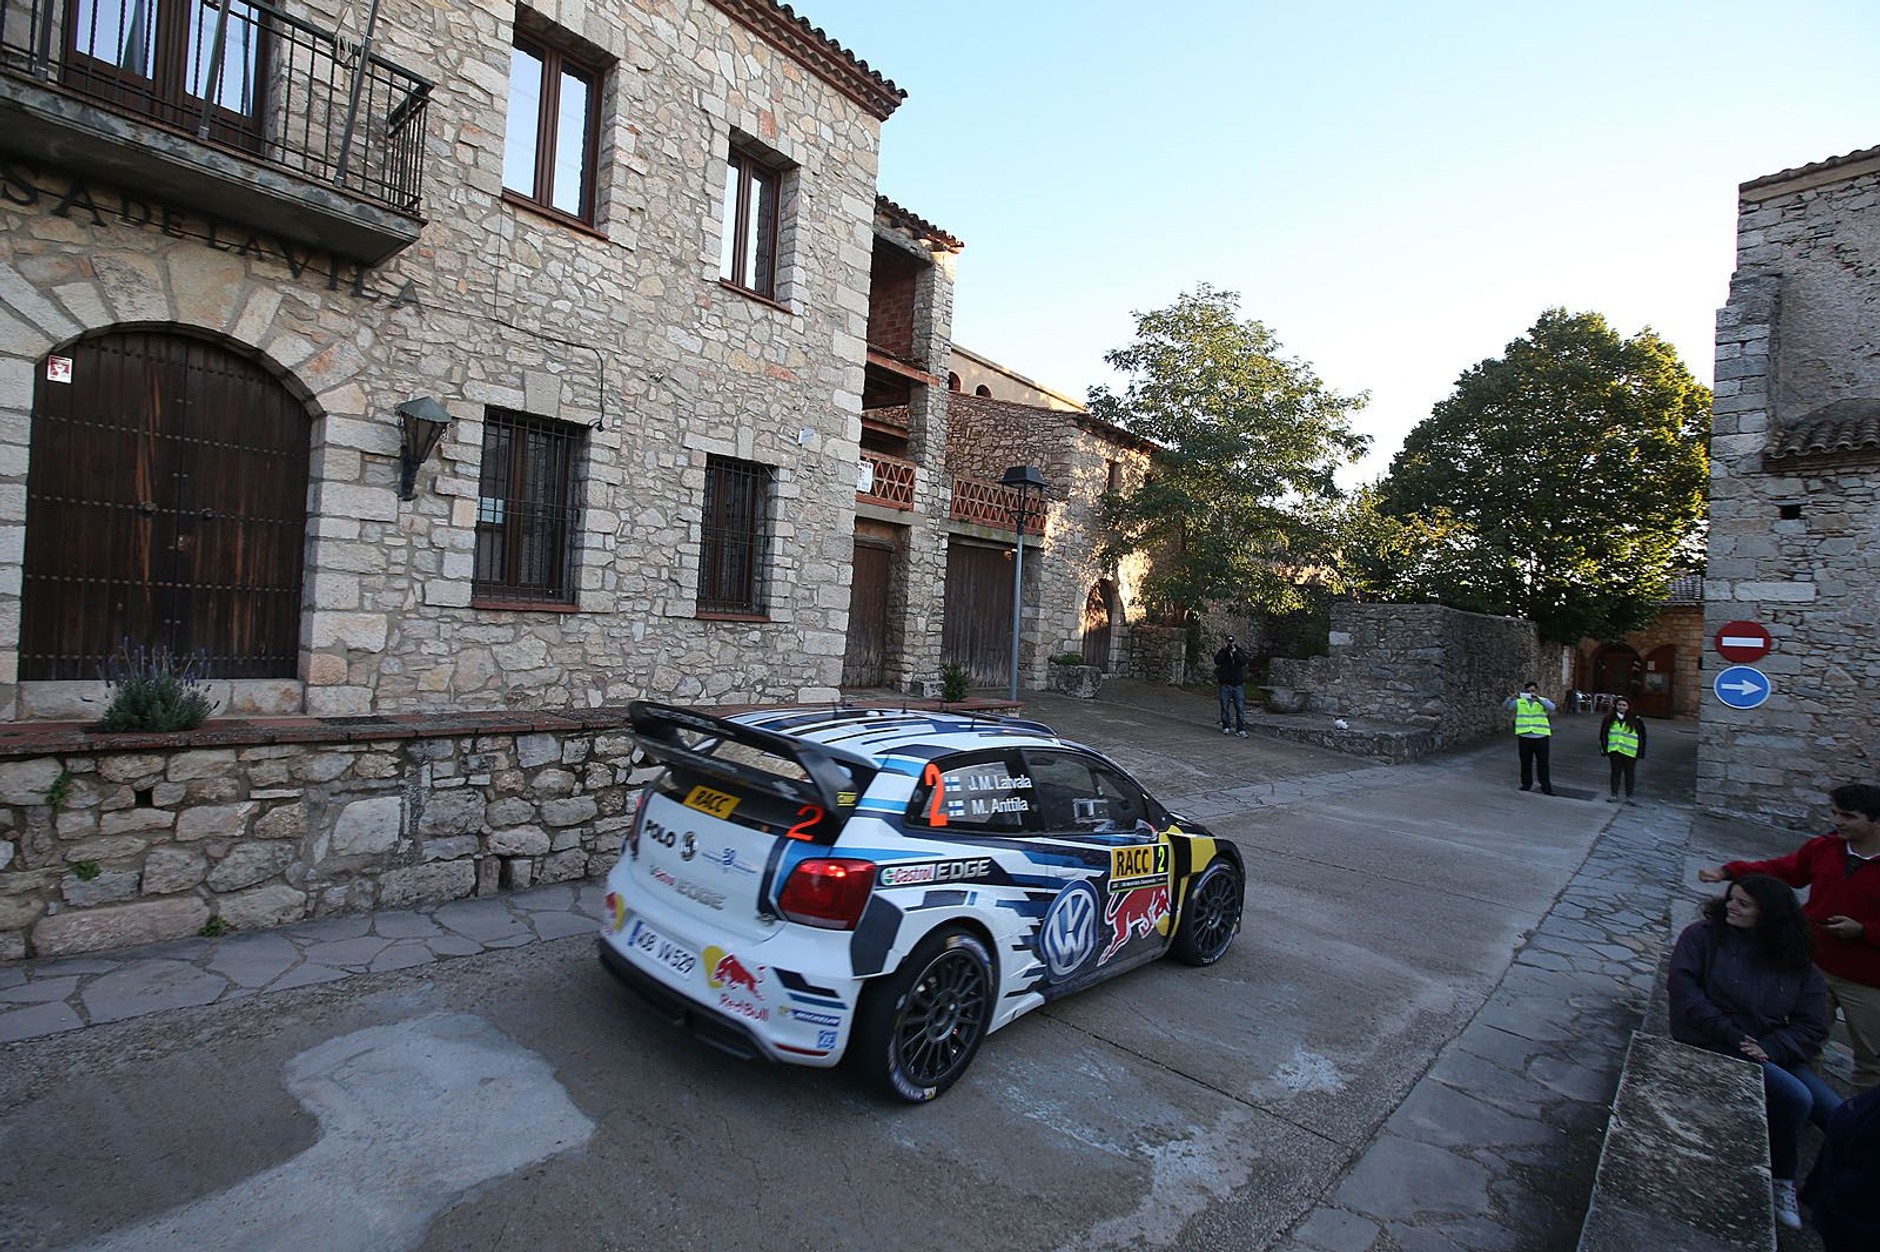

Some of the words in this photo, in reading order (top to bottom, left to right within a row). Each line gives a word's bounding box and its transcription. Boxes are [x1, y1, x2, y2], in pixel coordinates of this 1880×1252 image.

[994, 773, 1033, 789] Latvala
[694, 790, 731, 813] RACC
[925, 764, 948, 827] 2
[971, 798, 989, 815] M.
[991, 796, 1030, 814] Anttila
[644, 819, 676, 848] POLO
[784, 805, 825, 841] 2
[895, 866, 933, 883] Castrol
[936, 859, 992, 881] EDGE
[1116, 848, 1150, 877] RACC
[1158, 846, 1166, 874] 2
